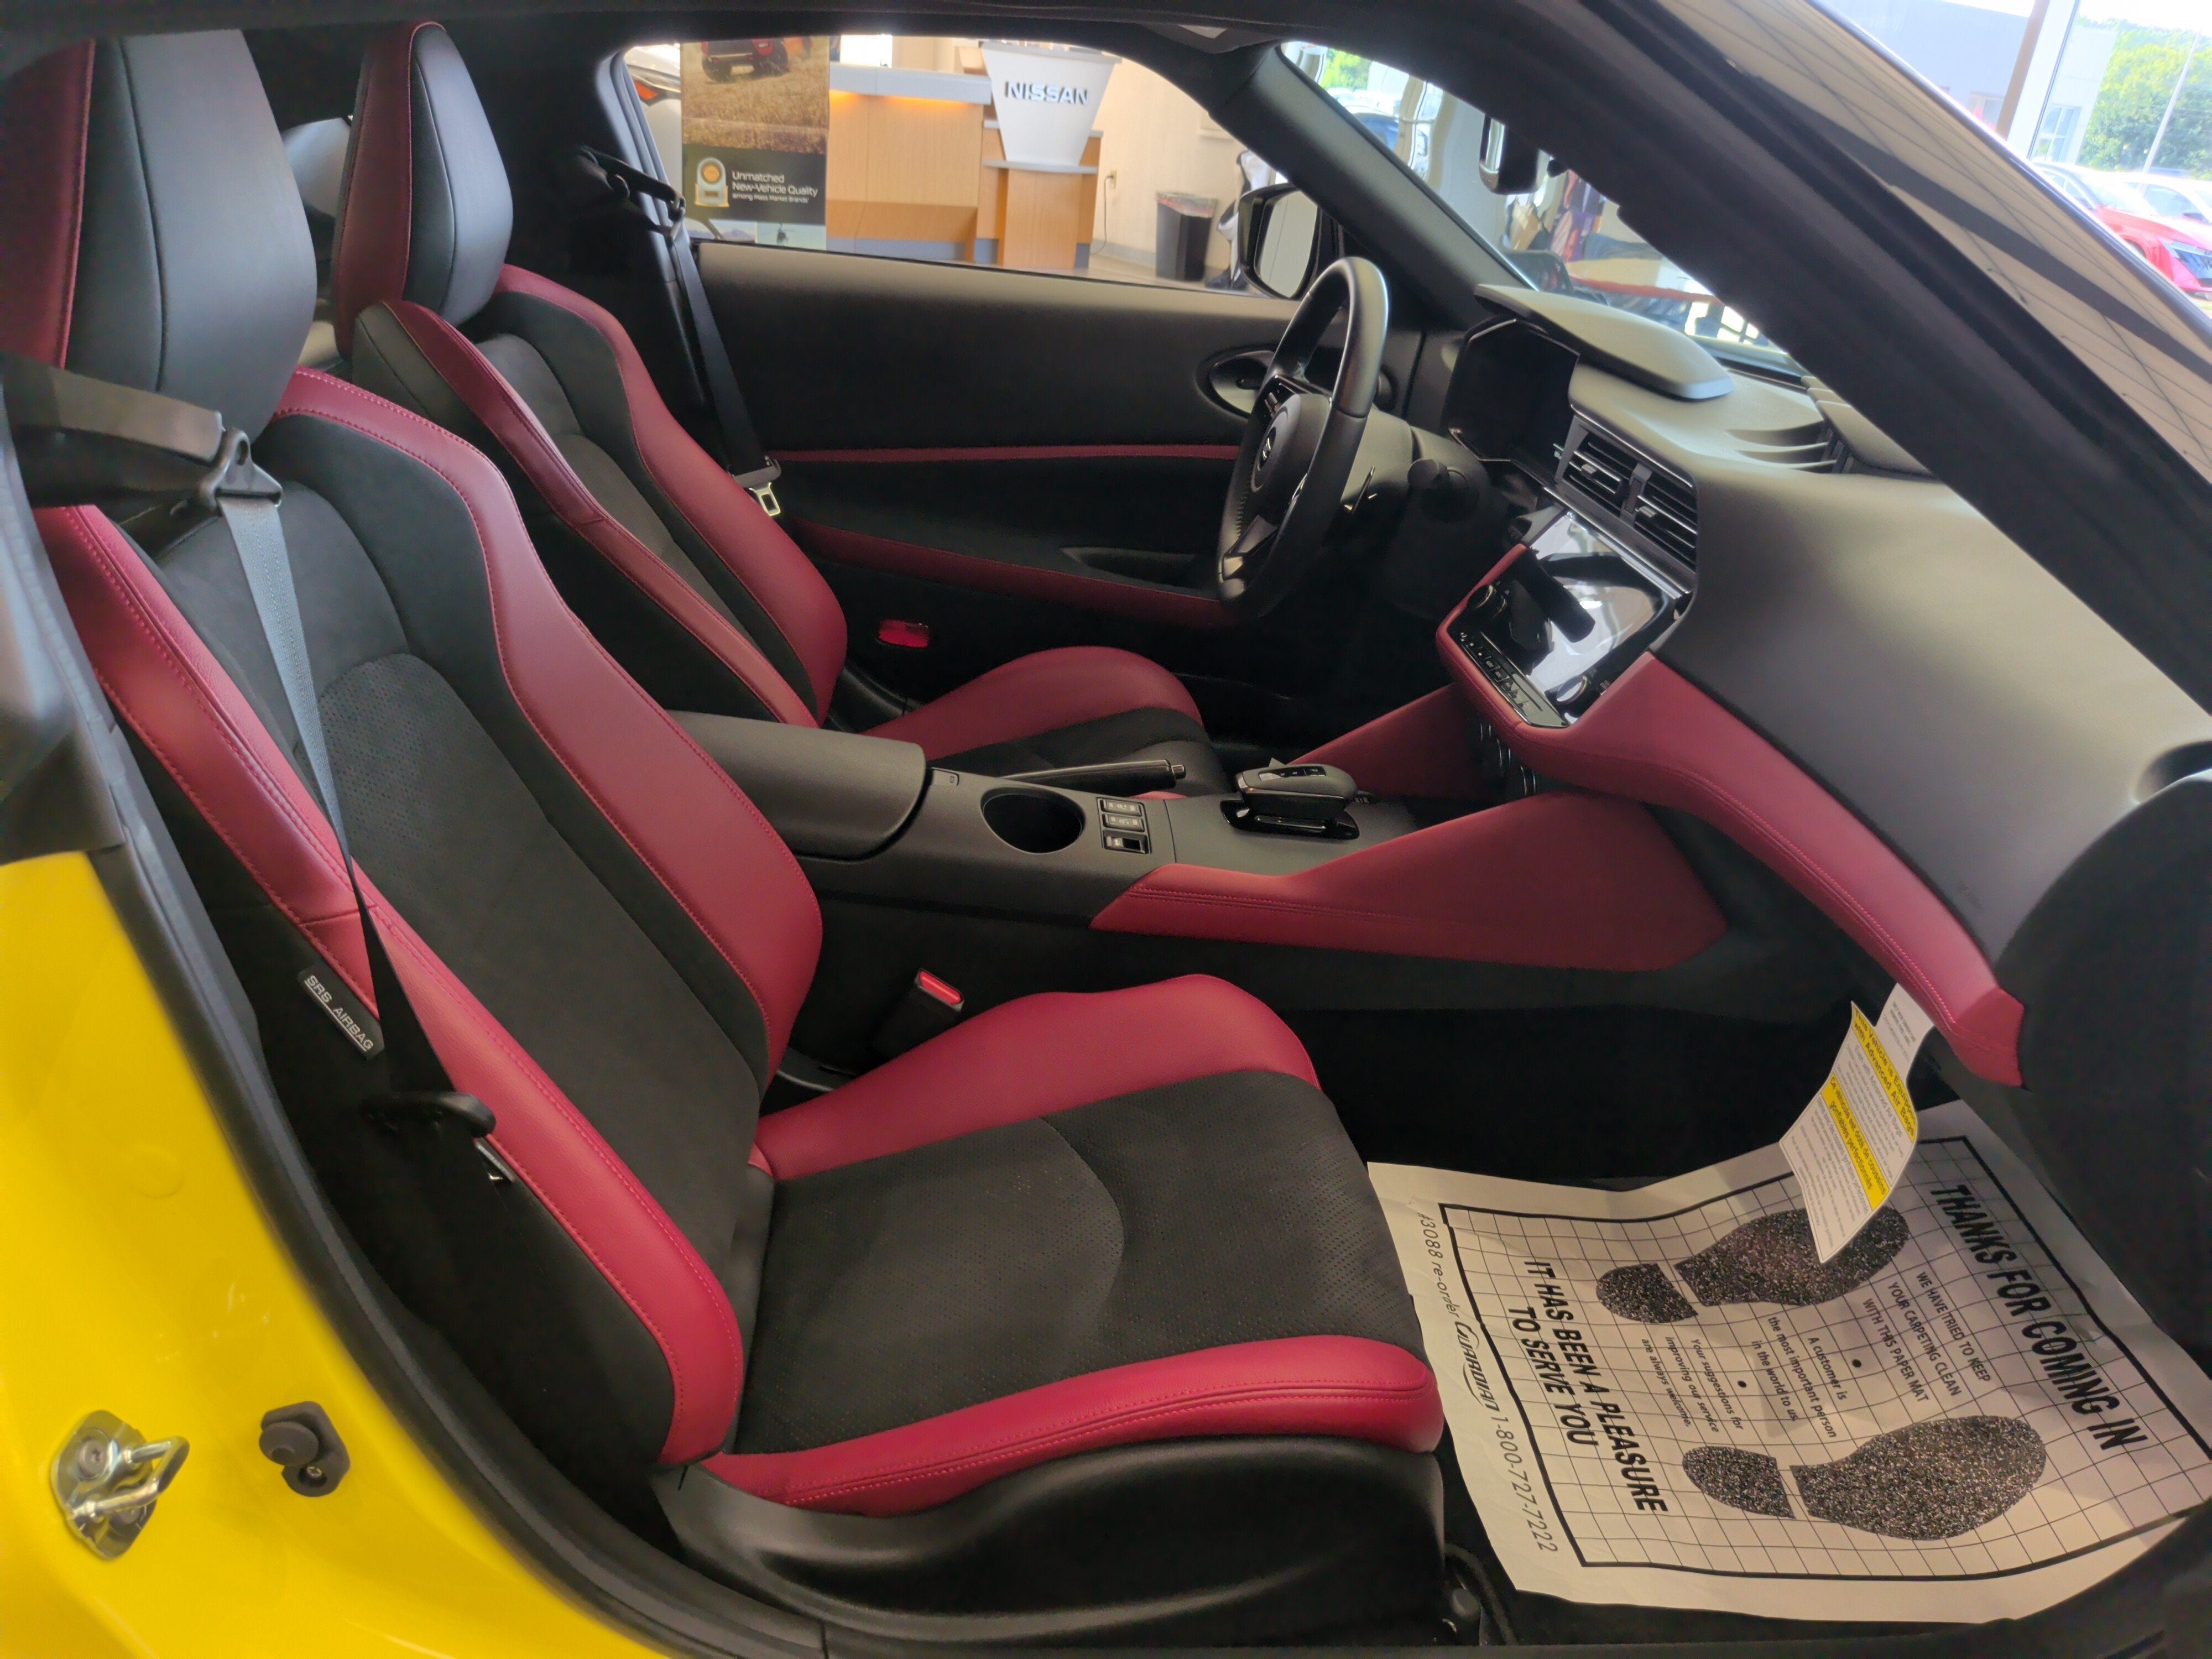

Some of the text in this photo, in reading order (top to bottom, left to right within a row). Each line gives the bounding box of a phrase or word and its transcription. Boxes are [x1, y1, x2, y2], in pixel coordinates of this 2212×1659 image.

[1005, 81, 1089, 105] NISSAN
[732, 171, 785, 183] Unmatched
[732, 181, 818, 197] New-Vehicle Quality
[307, 975, 374, 1051] SRS AIRBAG
[1869, 1029, 1887, 1066] Vehicle
[1866, 1042, 1891, 1090] Advanced
[1891, 1091, 1901, 1107] Air
[1901, 1107, 1914, 1136] Bags
[1863, 1148, 1869, 1159] de
[1868, 1159, 1886, 1195] coussins
[1863, 1298, 1929, 1402] WITH THIS PAPER MAT
[1888, 1282, 1962, 1396] YOUR CARPETING CLEAN
[1916, 1272, 1991, 1381] WE HAVE TRIED TO KEEP
[1930, 1184, 2148, 1451] THANKS FOR COMING IN
[1432, 1261, 1460, 1318] re-order
[1455, 1321, 1500, 1412] GUARDIAN
[1491, 1416, 1558, 1552] 1-800-727-7222
[1508, 1306, 1599, 1446] TO SERVE YOU
[1524, 1261, 1668, 1511] IT HAS BEEN A PLEASURE
[1642, 1338, 1691, 1427] are always welcome.
[1665, 1337, 1719, 1432] improving our service
[1691, 1339, 1743, 1430] Your suggestions for
[1751, 1340, 1762, 1349] in
[1757, 1352, 1770, 1366] the
[1766, 1368, 1788, 1394] world
[1780, 1396, 1791, 1407] to
[1768, 1317, 1837, 1438] the most important person
[1813, 1346, 1841, 1389] customer
[1837, 1391, 1848, 1400] is
